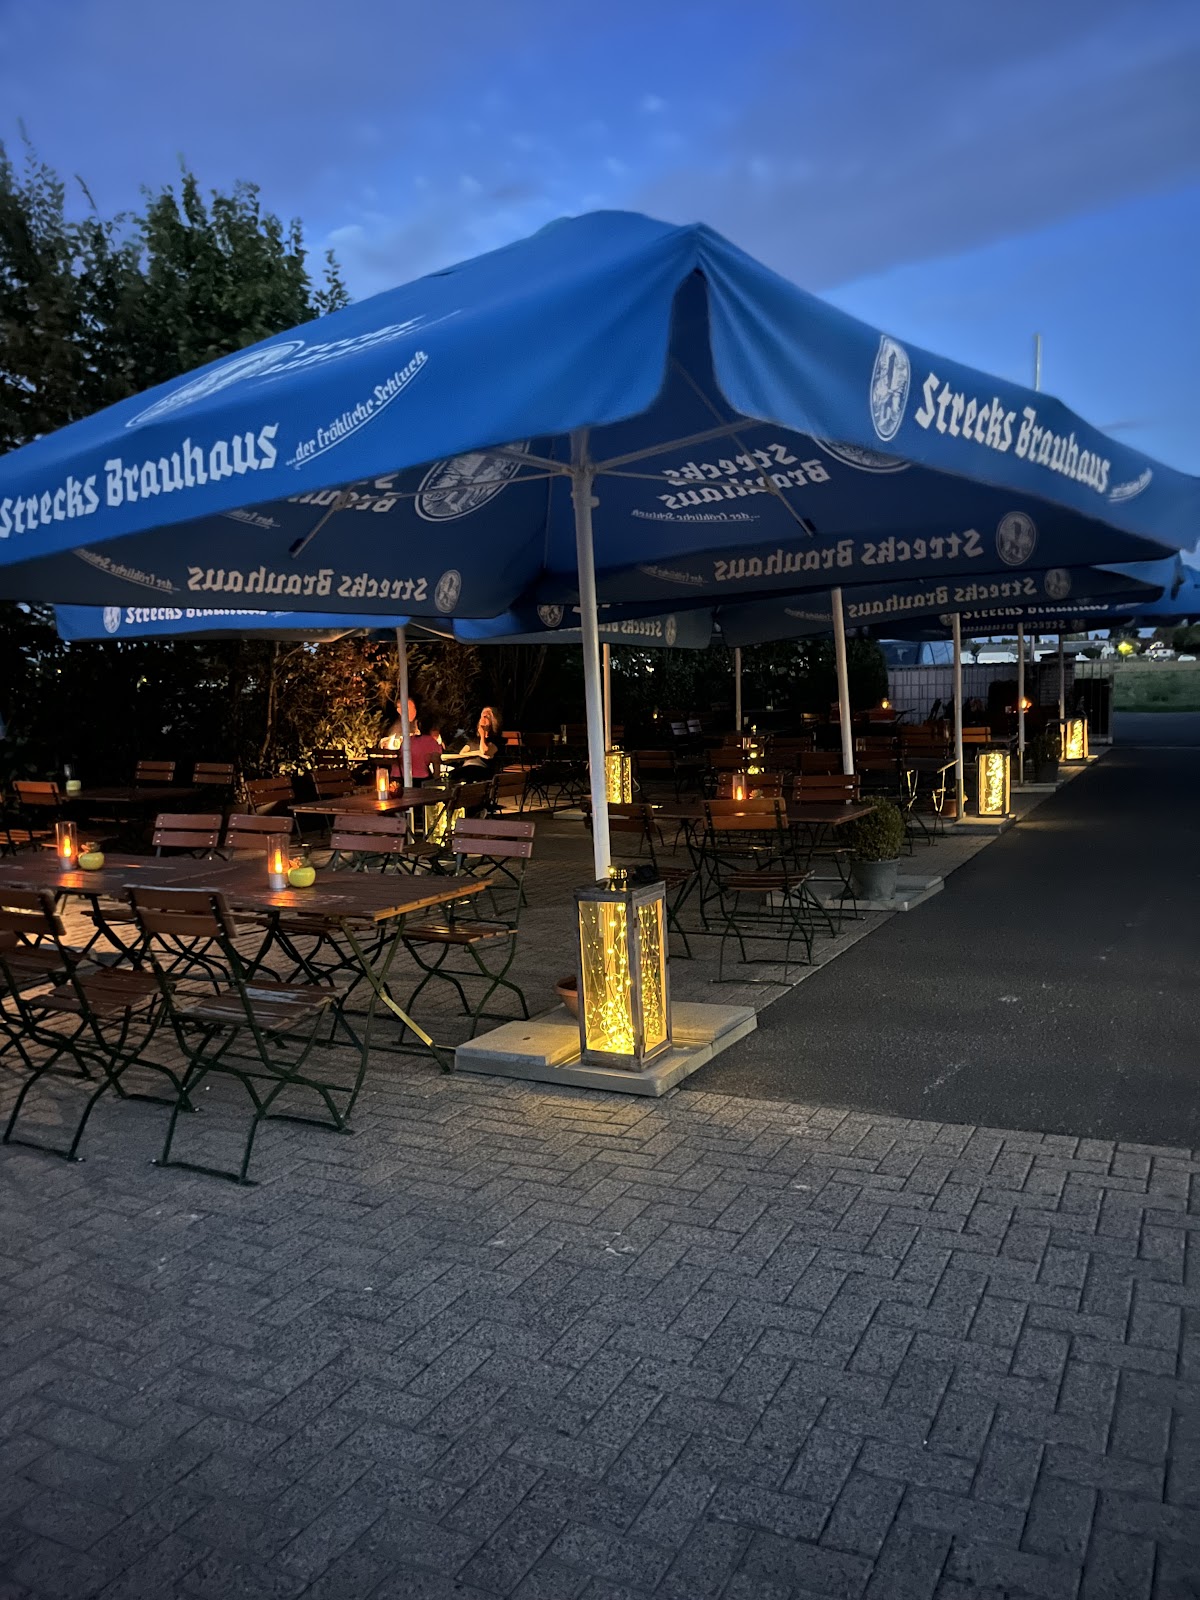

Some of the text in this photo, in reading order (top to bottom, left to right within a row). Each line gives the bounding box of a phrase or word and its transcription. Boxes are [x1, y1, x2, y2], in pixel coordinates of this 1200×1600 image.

[316, 398, 375, 449] fröhliche
[372, 350, 428, 406] Schluck
[914, 371, 1111, 494] Strecks Brauhaus
[0, 422, 281, 539] Strecks Brauhaus
